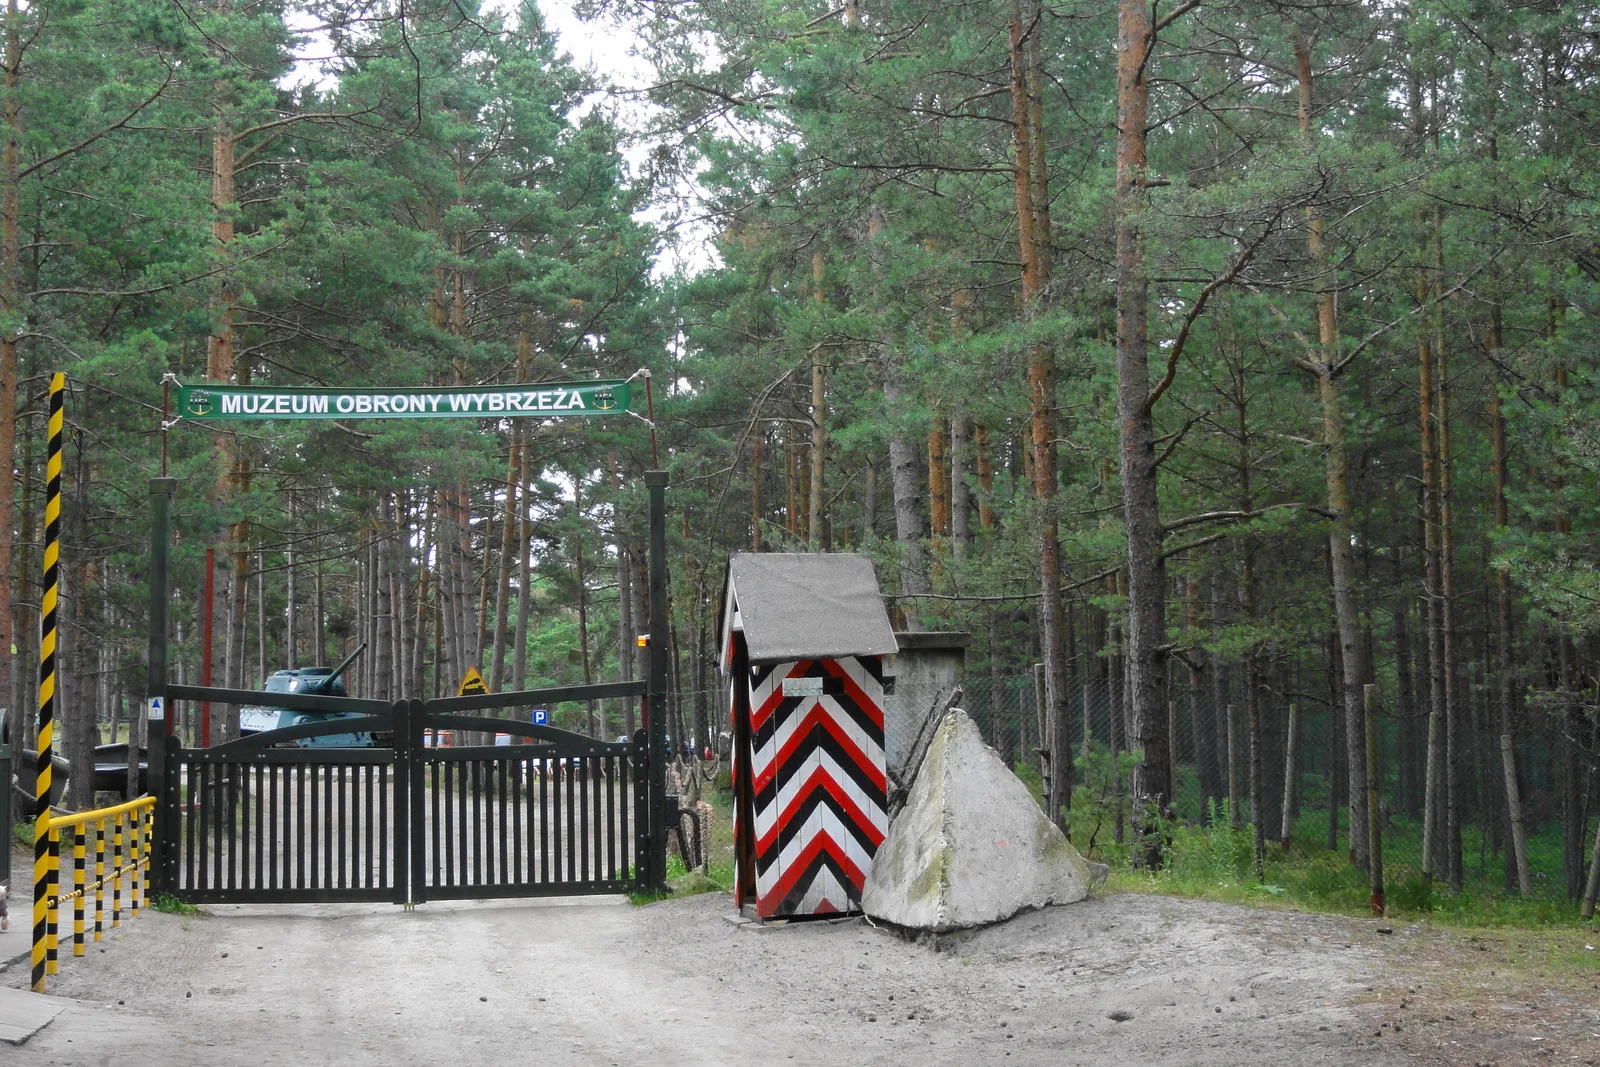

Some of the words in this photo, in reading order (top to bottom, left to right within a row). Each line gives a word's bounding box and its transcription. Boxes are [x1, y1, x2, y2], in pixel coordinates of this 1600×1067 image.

[221, 395, 328, 413] MUZEUM
[336, 394, 442, 413] OBRONY
[450, 388, 585, 411] WYBRZEŻA
[535, 711, 545, 723] P
